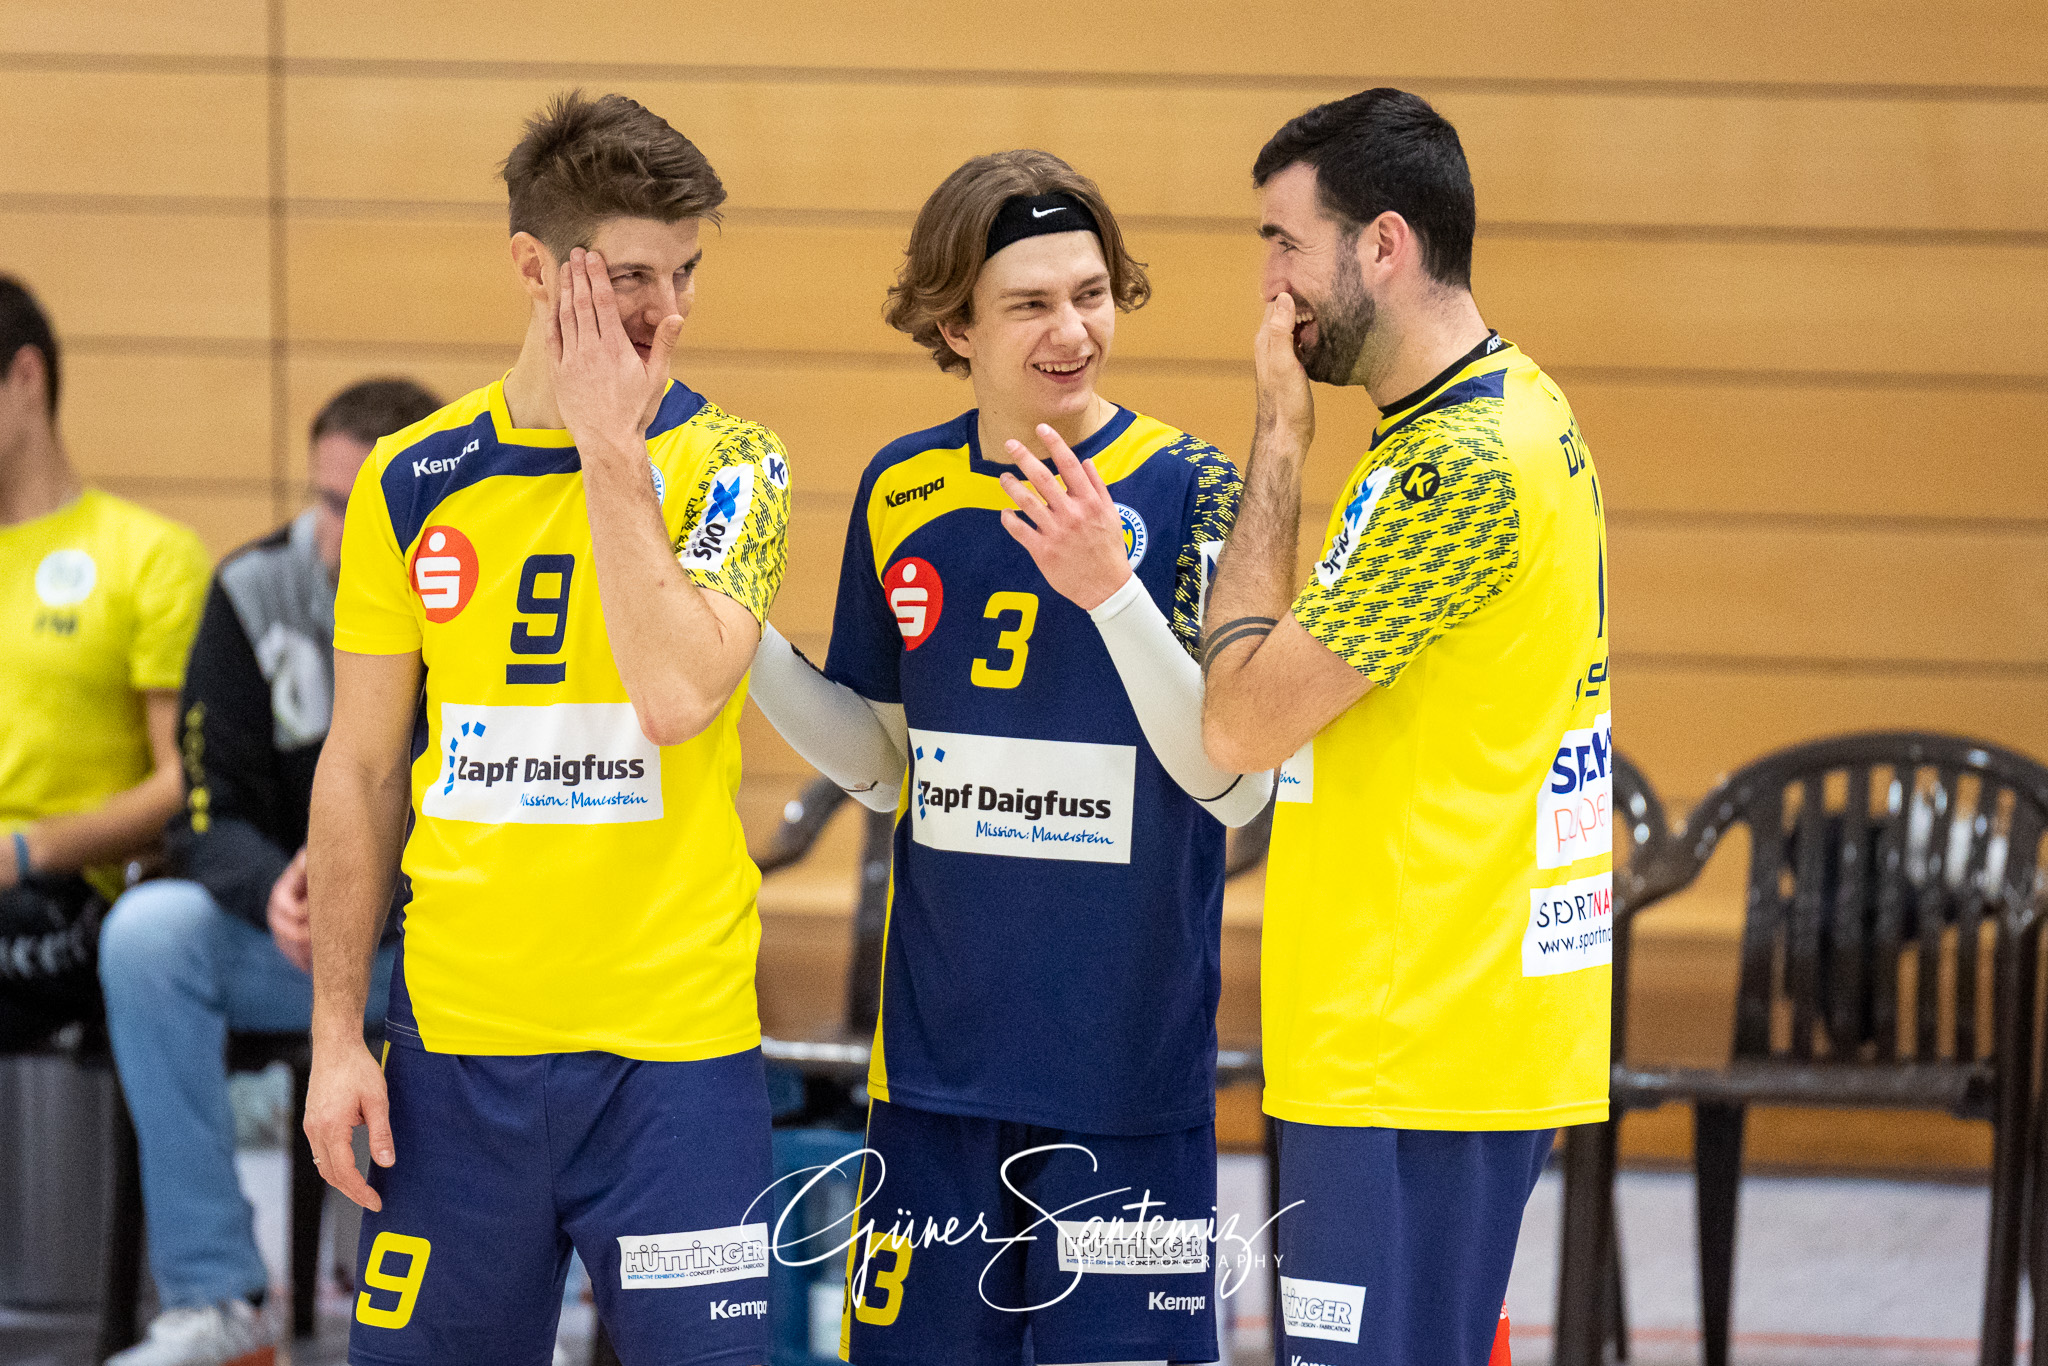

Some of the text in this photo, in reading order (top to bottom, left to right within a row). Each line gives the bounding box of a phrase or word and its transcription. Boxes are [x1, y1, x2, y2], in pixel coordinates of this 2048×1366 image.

[885, 476, 945, 508] Kempa
[1117, 506, 1145, 559] VOLLEYBALL
[509, 553, 575, 655] 9
[970, 591, 1039, 690] 3
[457, 753, 645, 788] Zapf Daigfuss
[920, 780, 1112, 820] Zapf Daigfuss
[975, 820, 1115, 845] Mission: Mauerstein
[356, 1231, 431, 1329] 9
[855, 1232, 913, 1326] 3
[709, 1299, 768, 1320] Kempa
[1148, 1291, 1206, 1316] Kempa
